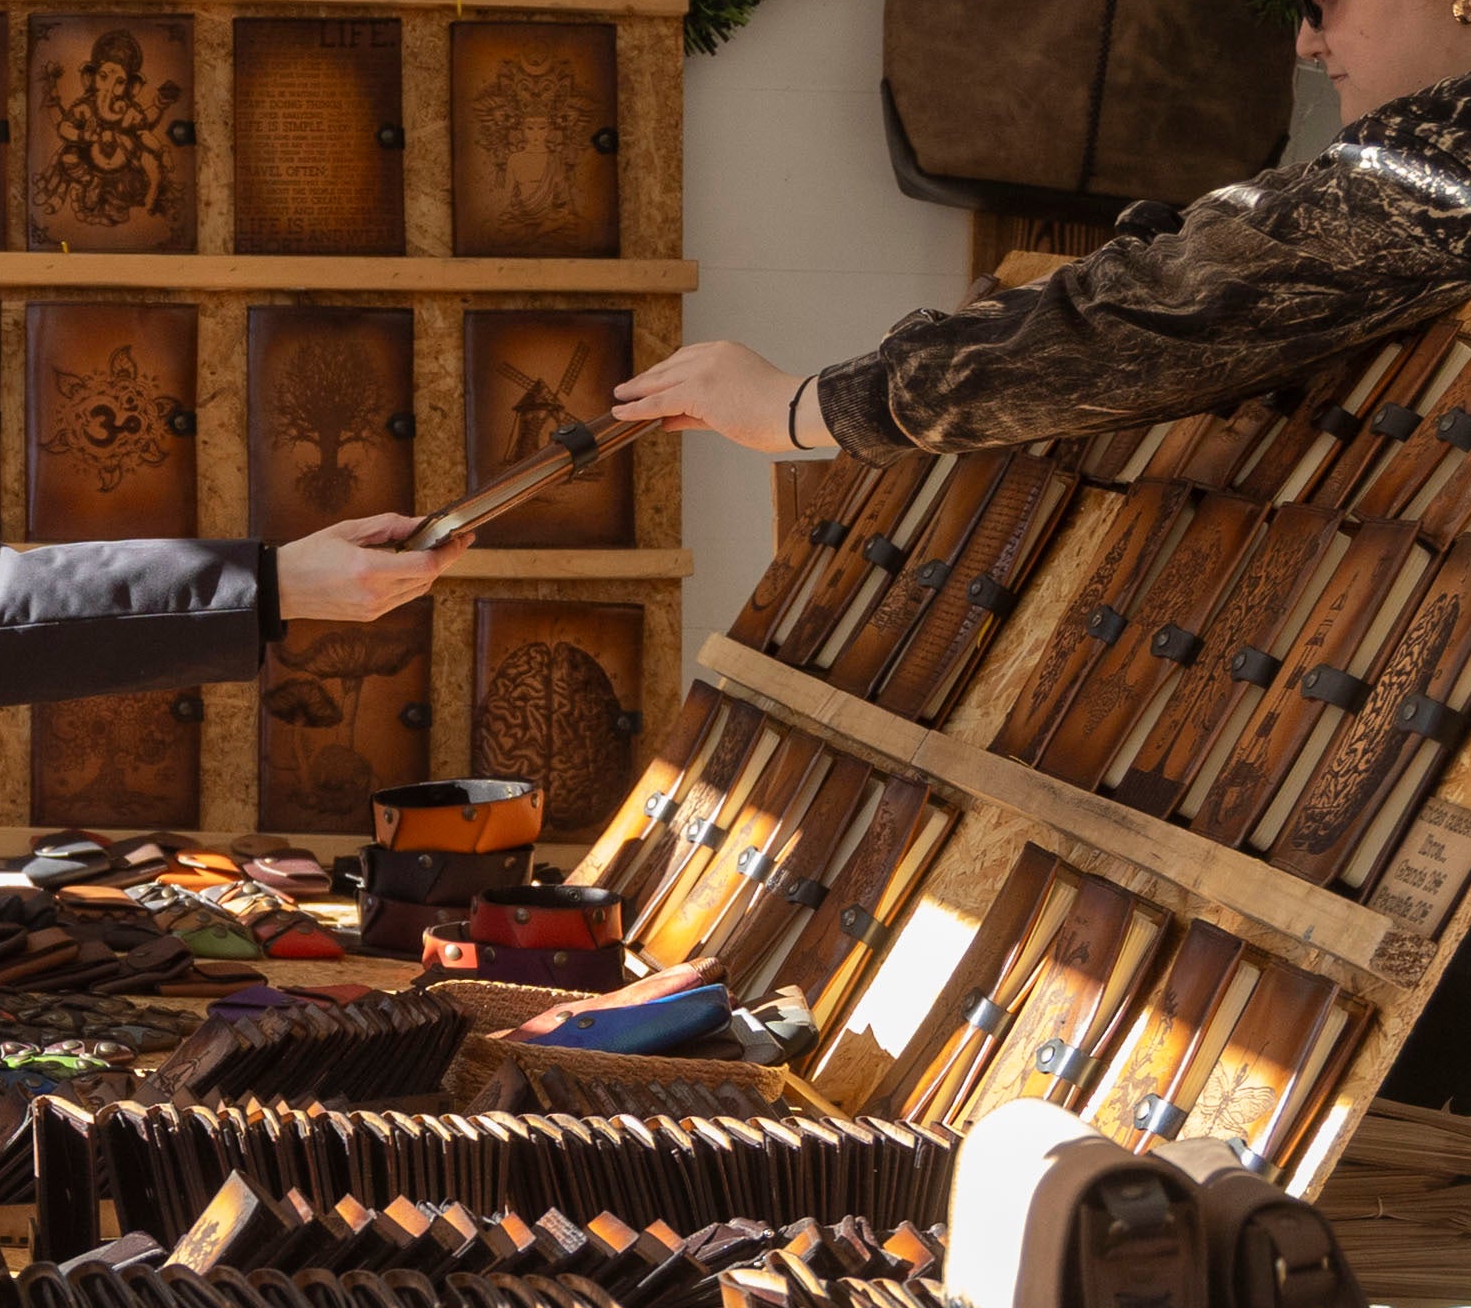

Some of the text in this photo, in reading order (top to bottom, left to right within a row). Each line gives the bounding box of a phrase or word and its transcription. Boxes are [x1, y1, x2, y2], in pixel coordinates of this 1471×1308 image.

[319, 20, 395, 48] LIFE.
[237, 122, 263, 132] LIFE
[268, 122, 278, 132] IS
[238, 166, 282, 177] TRAVEL
[238, 218, 281, 235] LIFE
[287, 218, 305, 235] IS
